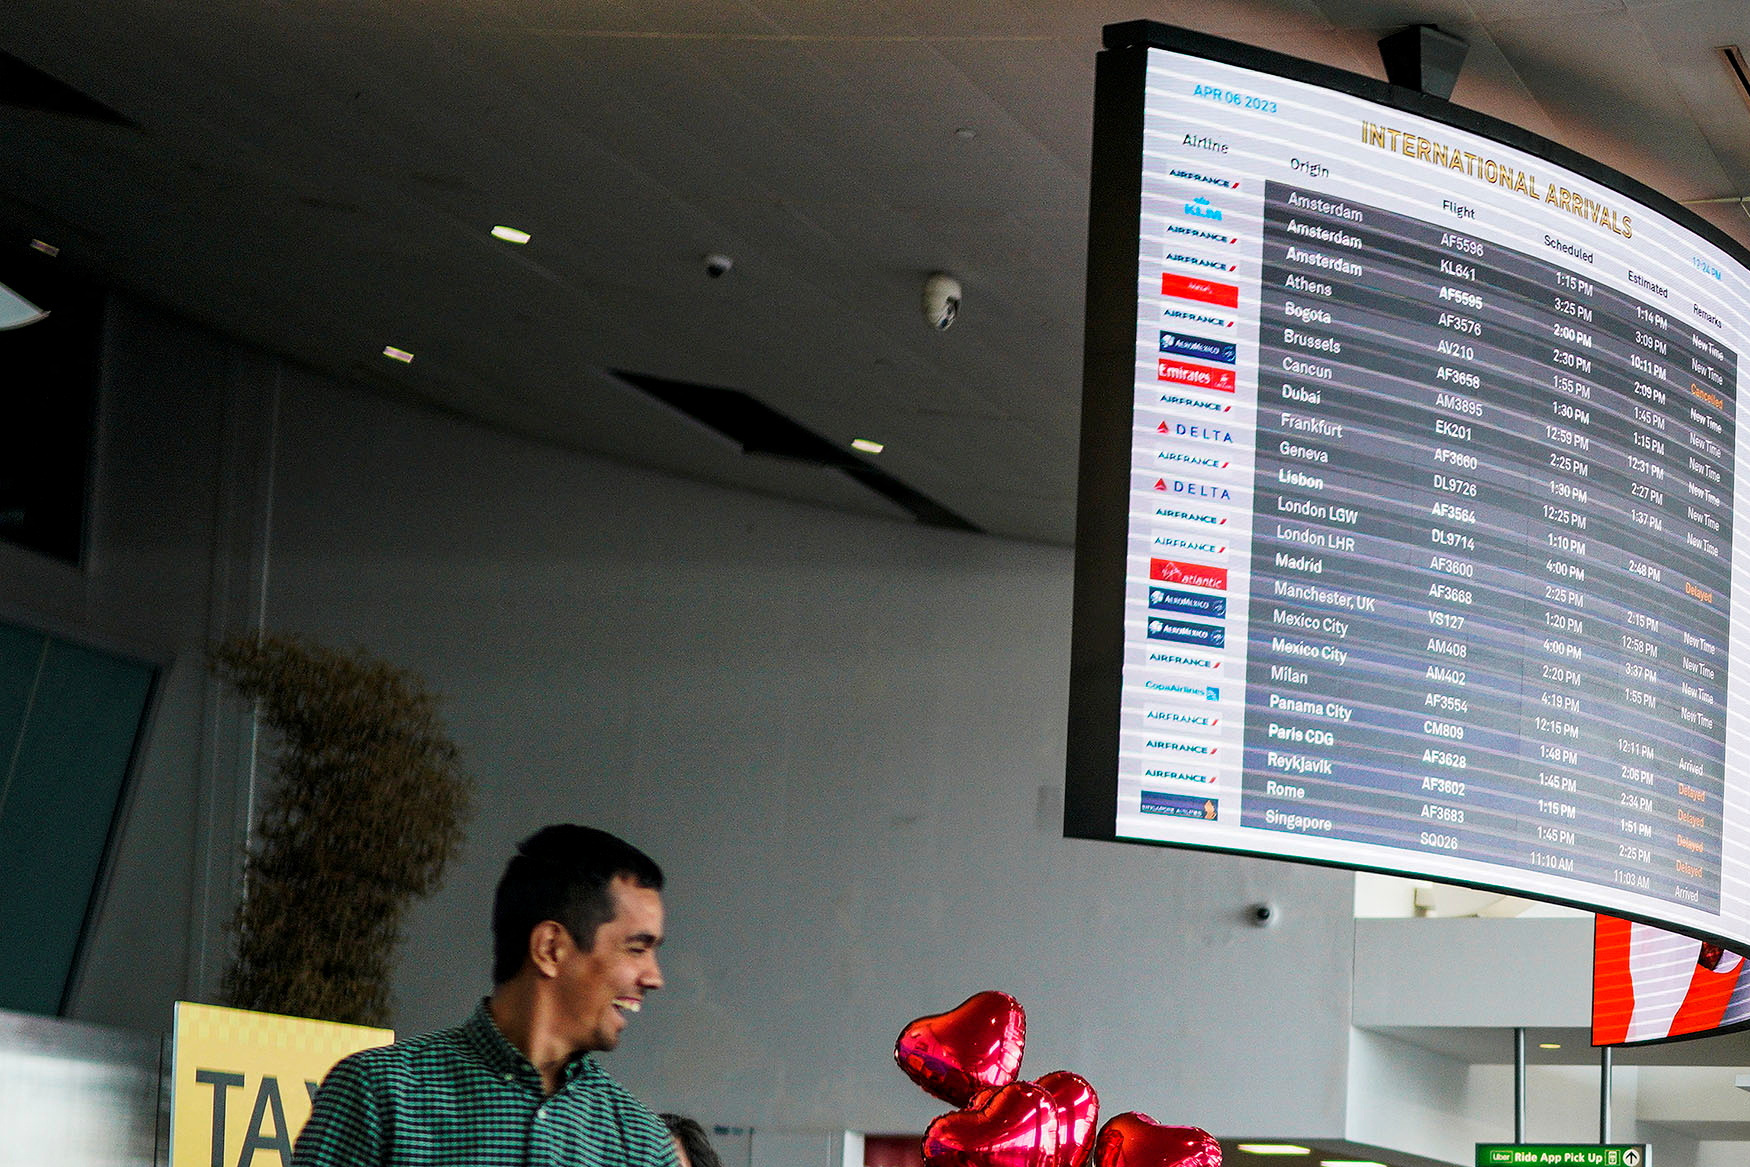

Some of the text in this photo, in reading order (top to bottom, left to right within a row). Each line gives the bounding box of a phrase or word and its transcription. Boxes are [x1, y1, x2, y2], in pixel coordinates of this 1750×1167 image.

[1194, 84, 1277, 113] APR 06 2023
[1183, 134, 1229, 154] Airline
[1291, 158, 1329, 178] Origin
[1362, 120, 1633, 239] INTERNATIONAL ARRIVALS
[1184, 204, 1223, 221] KLM
[1288, 192, 1363, 221] Amsterdam
[1443, 200, 1475, 219] Flight
[1287, 220, 1362, 249] Amsterdam
[1544, 235, 1594, 264] Scheduled
[1286, 247, 1362, 277] Amsterdam
[1285, 275, 1332, 296] Athens
[1555, 271, 1593, 297] 1:15 PM
[1628, 271, 1668, 298] Estimated
[1439, 286, 1483, 310] AF5595
[1285, 302, 1332, 324] Bogota
[1554, 297, 1593, 323] 3:25 PM
[1693, 303, 1721, 328] Remarks
[1438, 313, 1481, 336] AF3576
[1284, 329, 1341, 354] Brussels
[1437, 340, 1473, 360] AV210
[1283, 357, 1332, 380] Cancun
[1553, 349, 1591, 374] 2:30 PM
[1159, 363, 1210, 384] Emirates
[1437, 366, 1480, 389] AF3658
[1282, 384, 1321, 404] Dubai
[1436, 393, 1482, 417] AM3895
[1176, 424, 1233, 443] DELTA
[1281, 413, 1343, 438] Frankfurt
[1436, 420, 1472, 440] EK201
[1546, 425, 1589, 451] 12:59 PM
[1280, 441, 1328, 463] Geneva
[1434, 448, 1477, 470] AF3660
[1550, 453, 1588, 477] 2:25 PM
[1174, 481, 1231, 500] DELTA
[1279, 469, 1323, 490] Lisbon
[1434, 475, 1477, 497] DL9726
[1631, 483, 1663, 506] 2:27 PM
[1278, 496, 1358, 525] London LGW
[1432, 502, 1476, 524] AF3564
[1543, 504, 1587, 529] 12:25 PM
[1688, 507, 1703, 523] New
[1277, 525, 1355, 552] London LHR
[1432, 528, 1475, 551] DL9714
[1276, 552, 1322, 574] Madrid
[1430, 556, 1473, 577] AF3600
[1546, 559, 1585, 581] 4:00 PM
[1275, 581, 1375, 611] Manchester, UK
[1429, 584, 1472, 604] AF3668
[1685, 582, 1713, 603] Delayed
[1273, 609, 1348, 637] Mexico City
[1428, 610, 1464, 630] VS127
[1545, 612, 1583, 634] 1:20 PM
[1628, 611, 1659, 633] 2:15 PM
[1272, 637, 1347, 666] Mexico City
[1427, 638, 1467, 658] AM408
[1271, 665, 1308, 685] Milan
[1426, 666, 1466, 686] AM402
[1270, 694, 1352, 723] Panama City
[1425, 693, 1468, 713] AF3554
[1541, 691, 1580, 713] 4:19 PM
[1269, 724, 1334, 746] Paris CDG
[1424, 720, 1464, 740] CM809
[1535, 717, 1579, 739] 12:15 PM
[1268, 752, 1332, 774] Reykjavik
[1423, 749, 1466, 768] AF3628
[1679, 757, 1703, 775] Arrived
[1267, 781, 1305, 799] Rome
[1422, 776, 1465, 796] AF3602
[1678, 783, 1706, 802] Delayed
[1265, 810, 1332, 831] Singapore
[1421, 805, 1464, 823] AF3683
[1421, 832, 1457, 849] SQ026
[1530, 852, 1574, 872] 11:10 AM
[1614, 870, 1650, 889] 11:03 AM
[1492, 1152, 1603, 1164] Uber Ride App Pick Up
